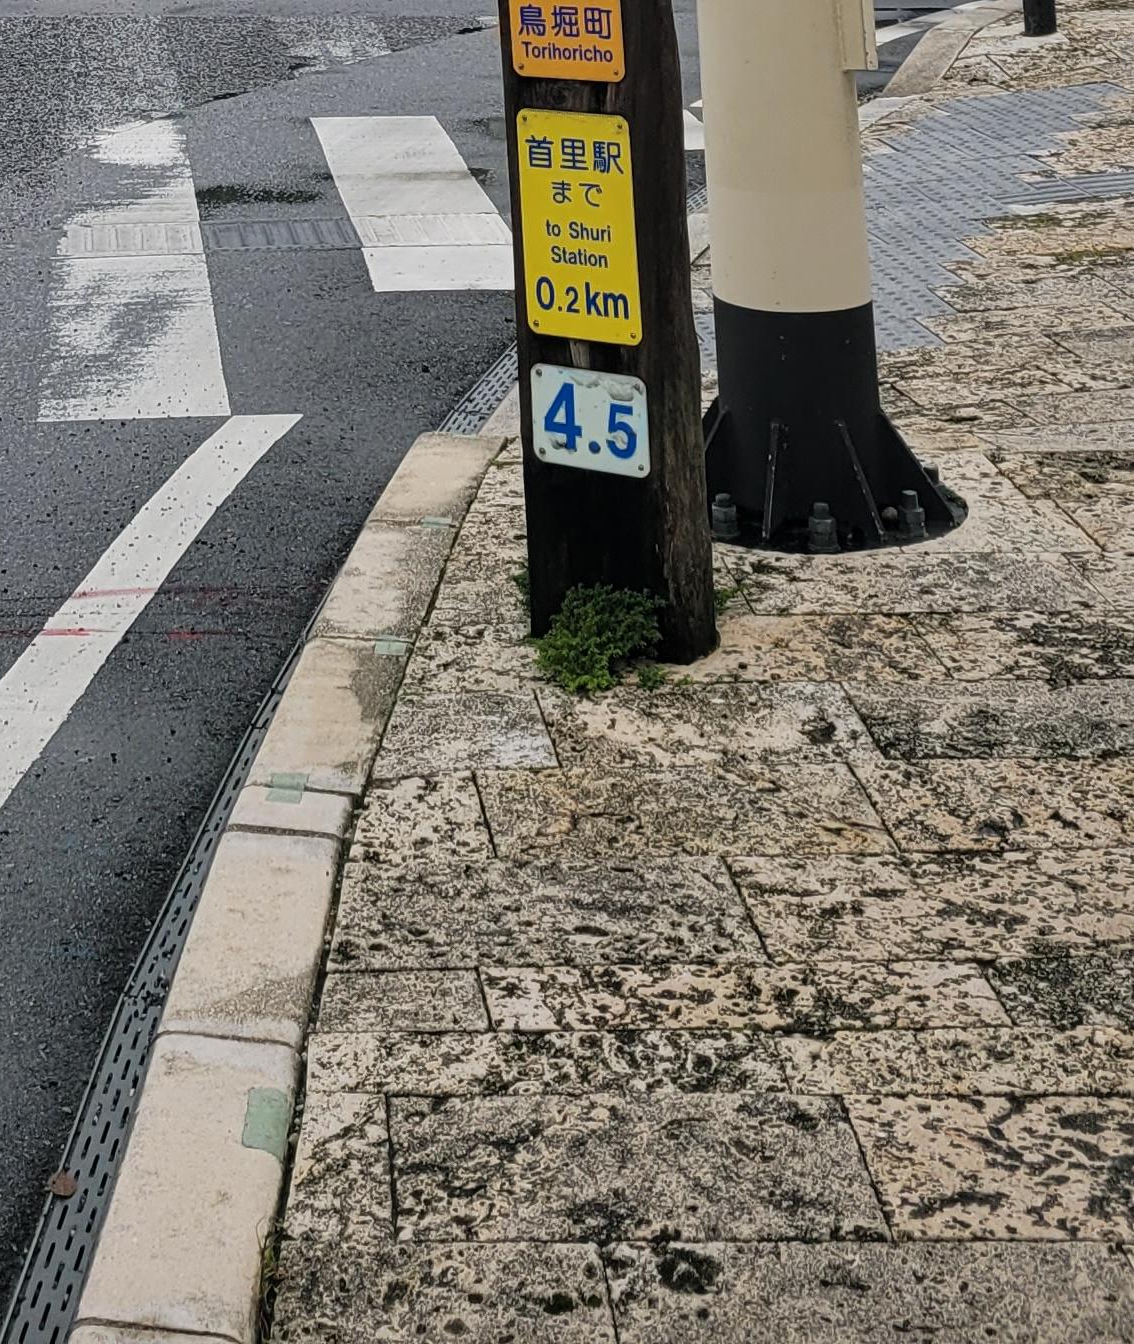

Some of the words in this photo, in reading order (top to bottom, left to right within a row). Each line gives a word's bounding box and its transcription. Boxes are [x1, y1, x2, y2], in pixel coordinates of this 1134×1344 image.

[518, 3, 613, 40] 鳥堀町
[521, 41, 613, 63] Torihoricho
[525, 135, 624, 175] 首里駅
[550, 180, 603, 207] まで
[546, 219, 562, 238] to
[568, 221, 612, 243] Shuri
[550, 245, 609, 269] Station
[543, 382, 638, 460] 4.5
